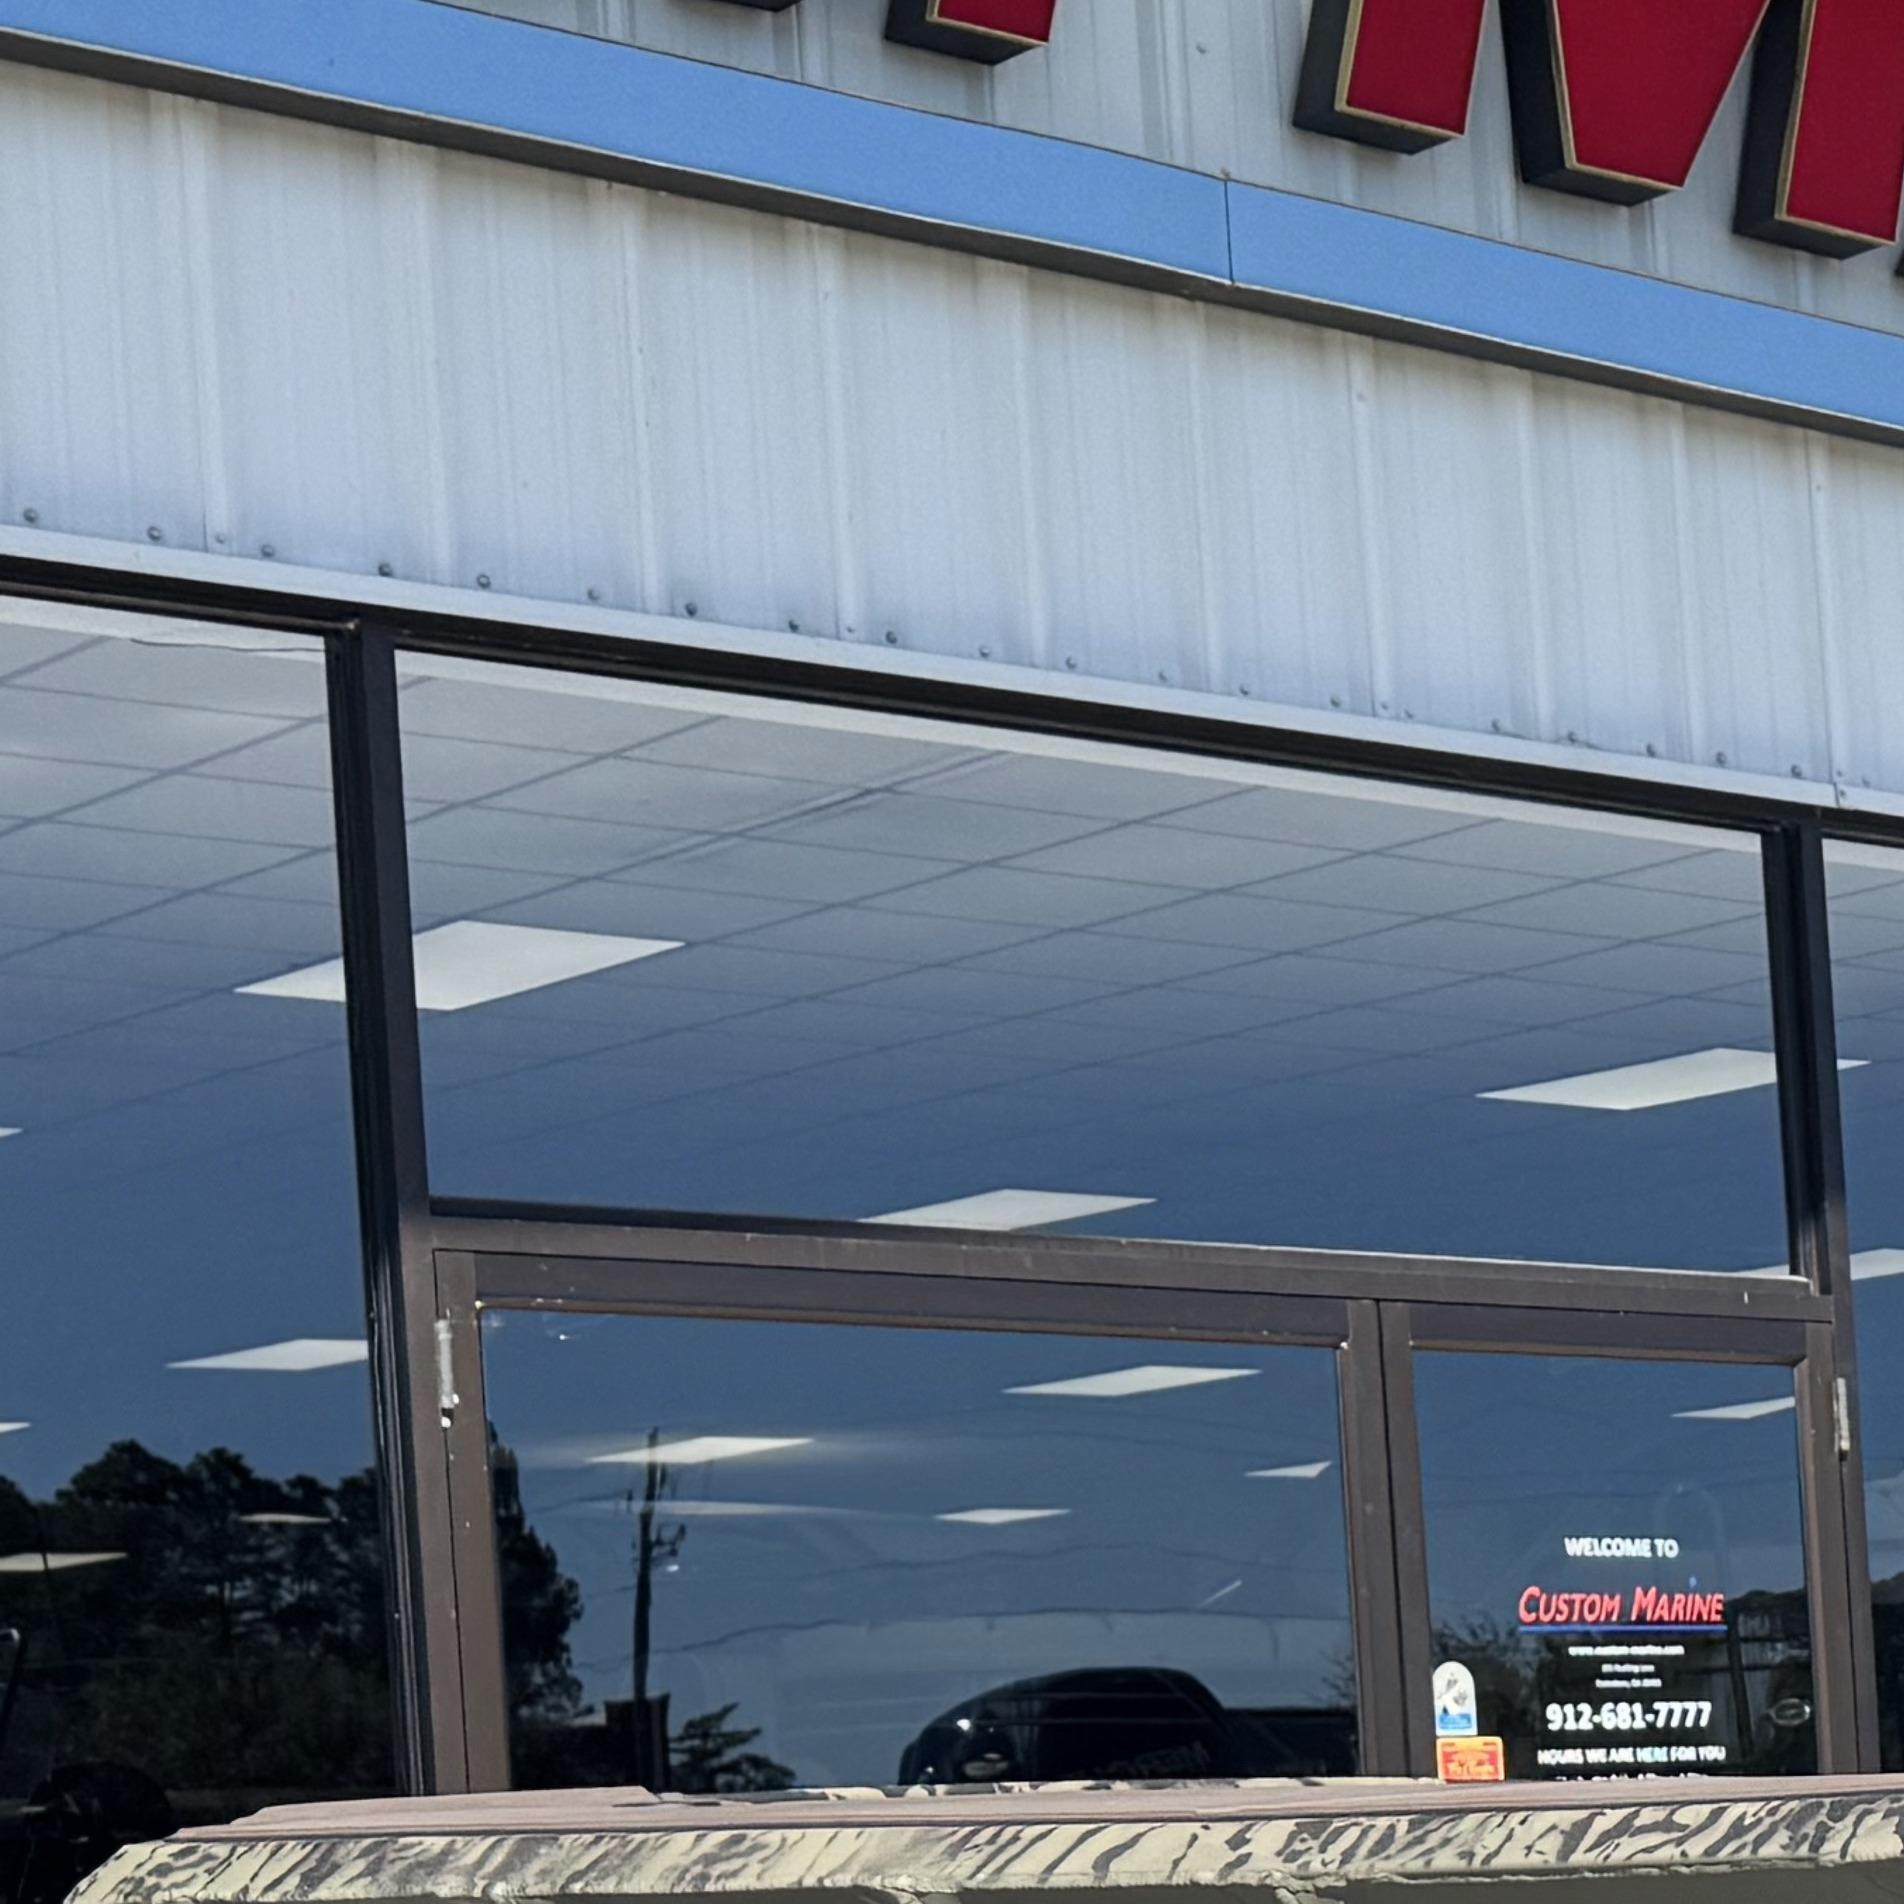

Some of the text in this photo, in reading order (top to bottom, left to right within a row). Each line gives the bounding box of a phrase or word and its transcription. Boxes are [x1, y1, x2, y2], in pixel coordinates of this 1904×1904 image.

[1563, 1537, 1680, 1559] WELCOME TO
[1546, 1701, 1713, 1731] 912-681-7777
[1537, 1745, 1727, 1765] HOURS WE ARE HERE FOR YOU
